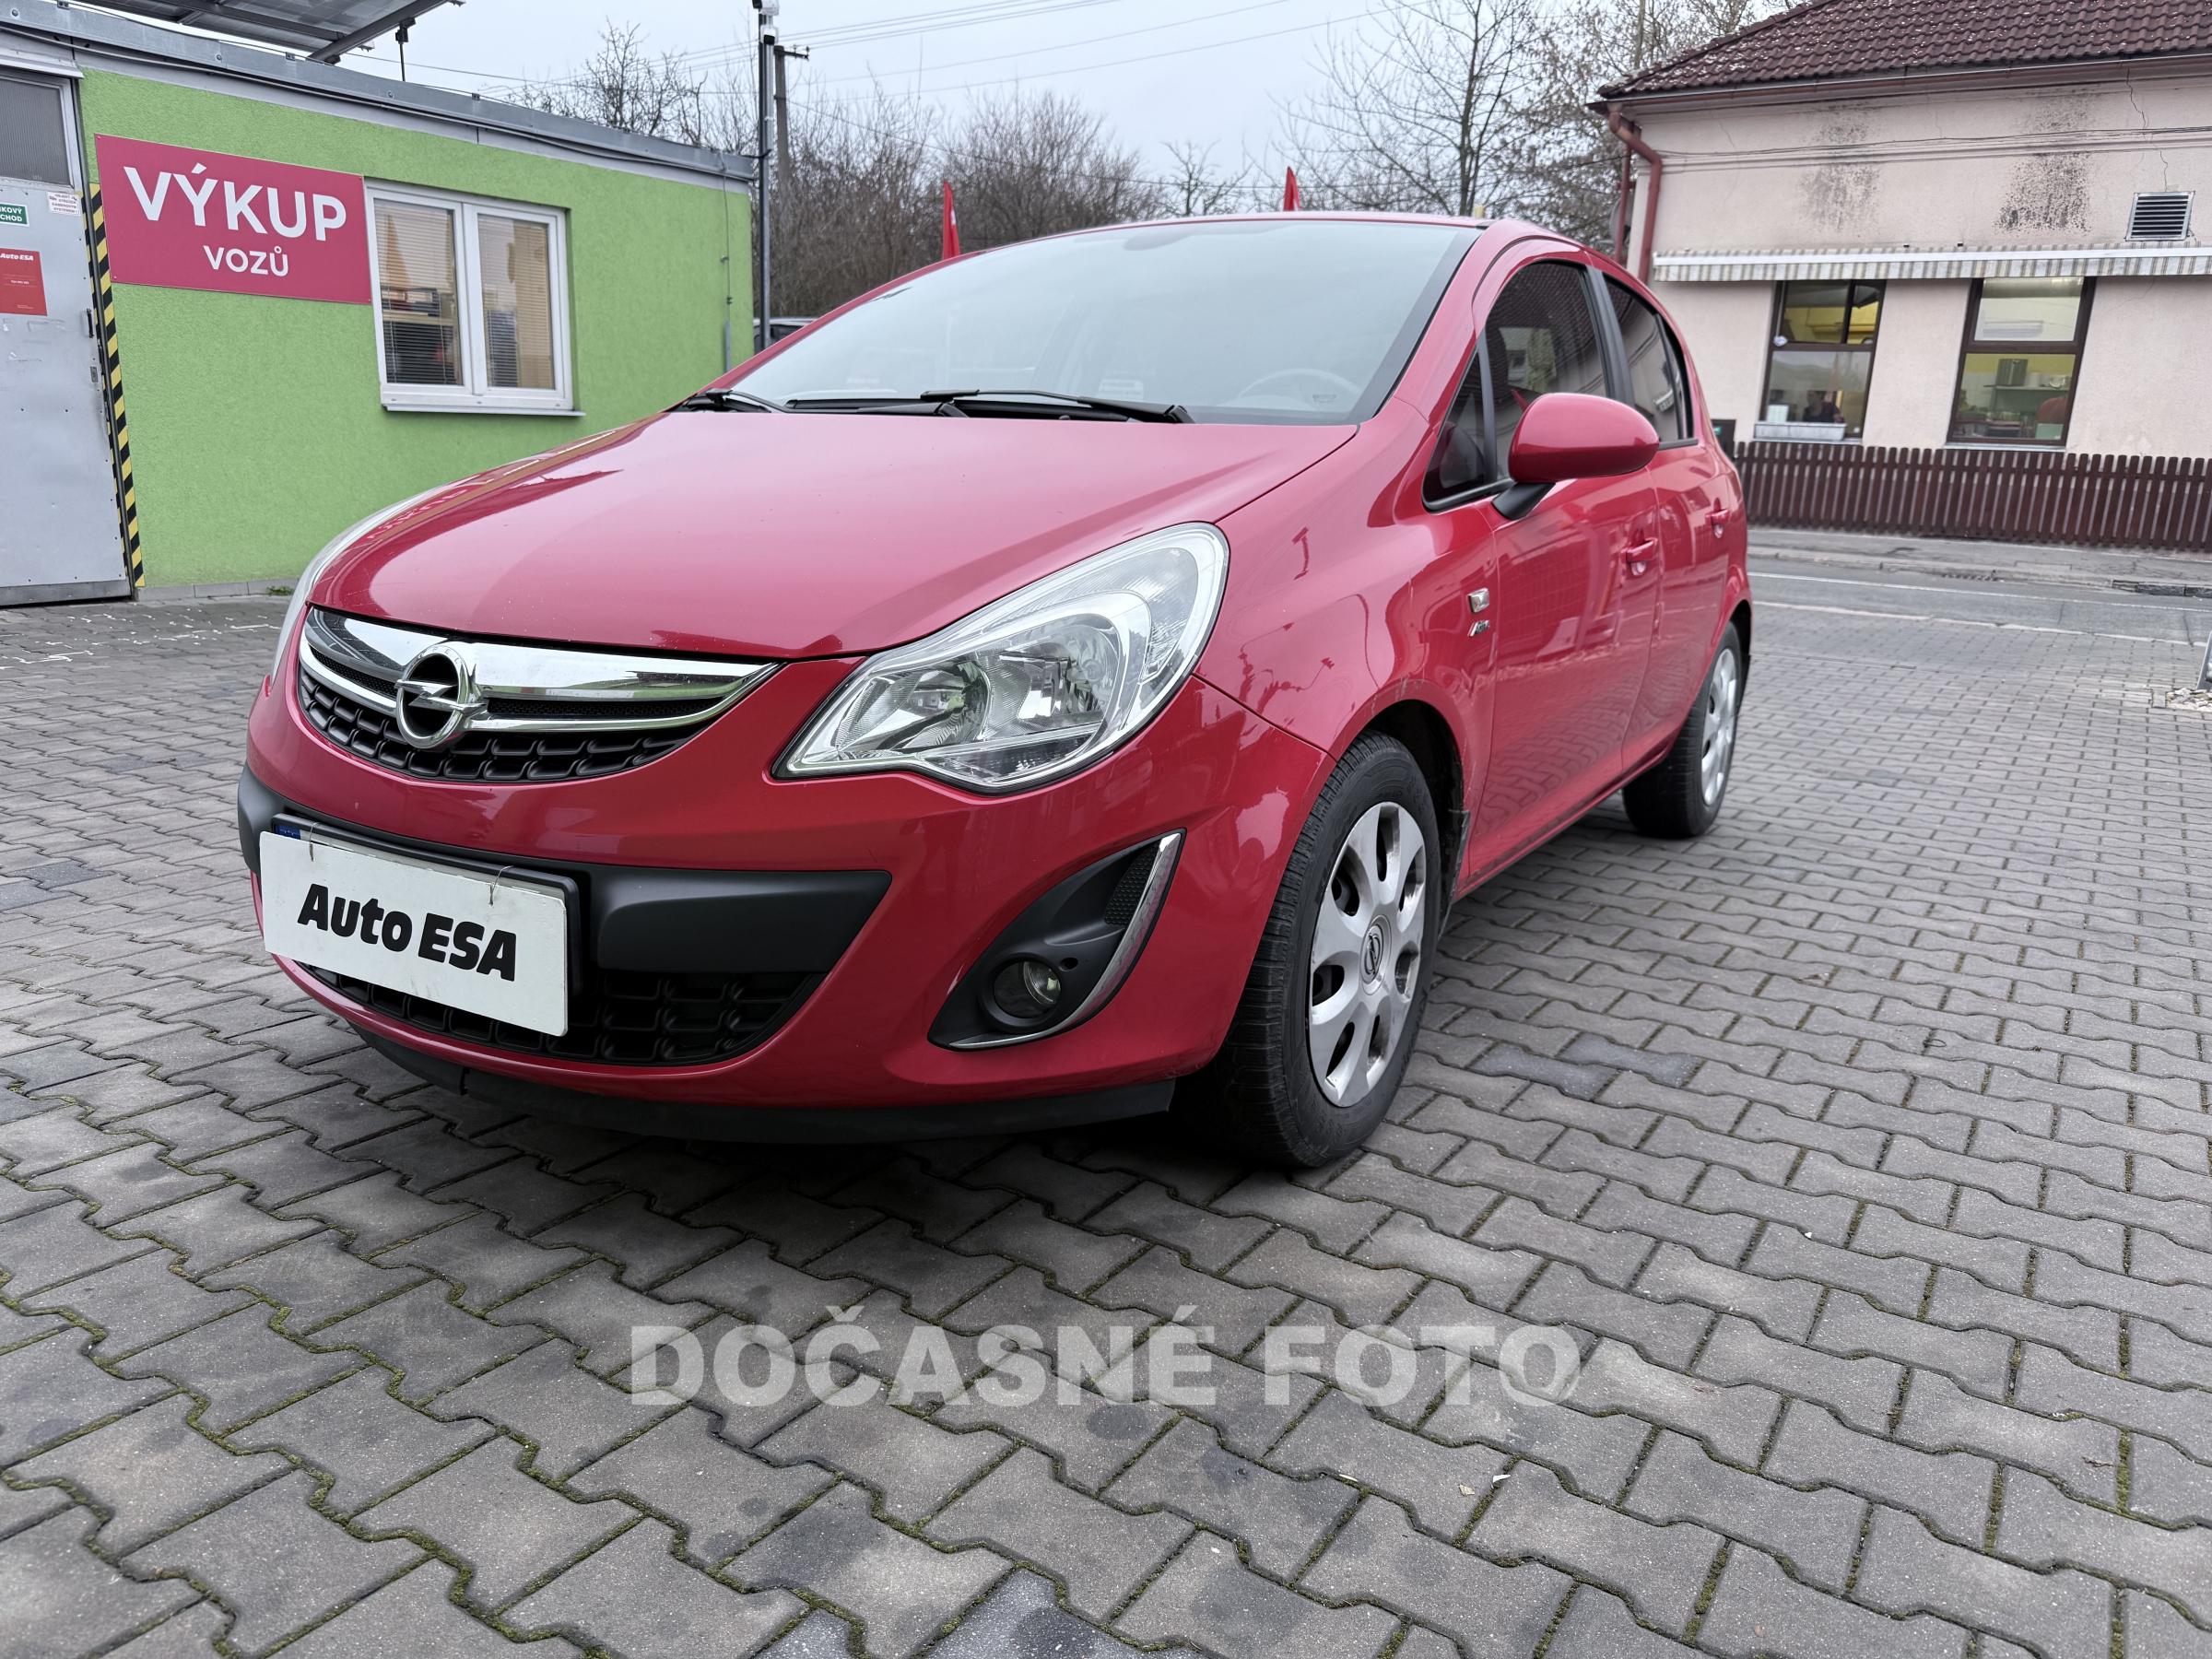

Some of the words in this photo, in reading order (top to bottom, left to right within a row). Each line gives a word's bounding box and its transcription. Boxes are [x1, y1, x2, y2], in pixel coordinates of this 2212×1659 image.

[124, 163, 347, 241] VÝKUP
[204, 245, 288, 277] VOZŮ
[298, 884, 412, 952] Auto
[418, 913, 516, 982] ESA
